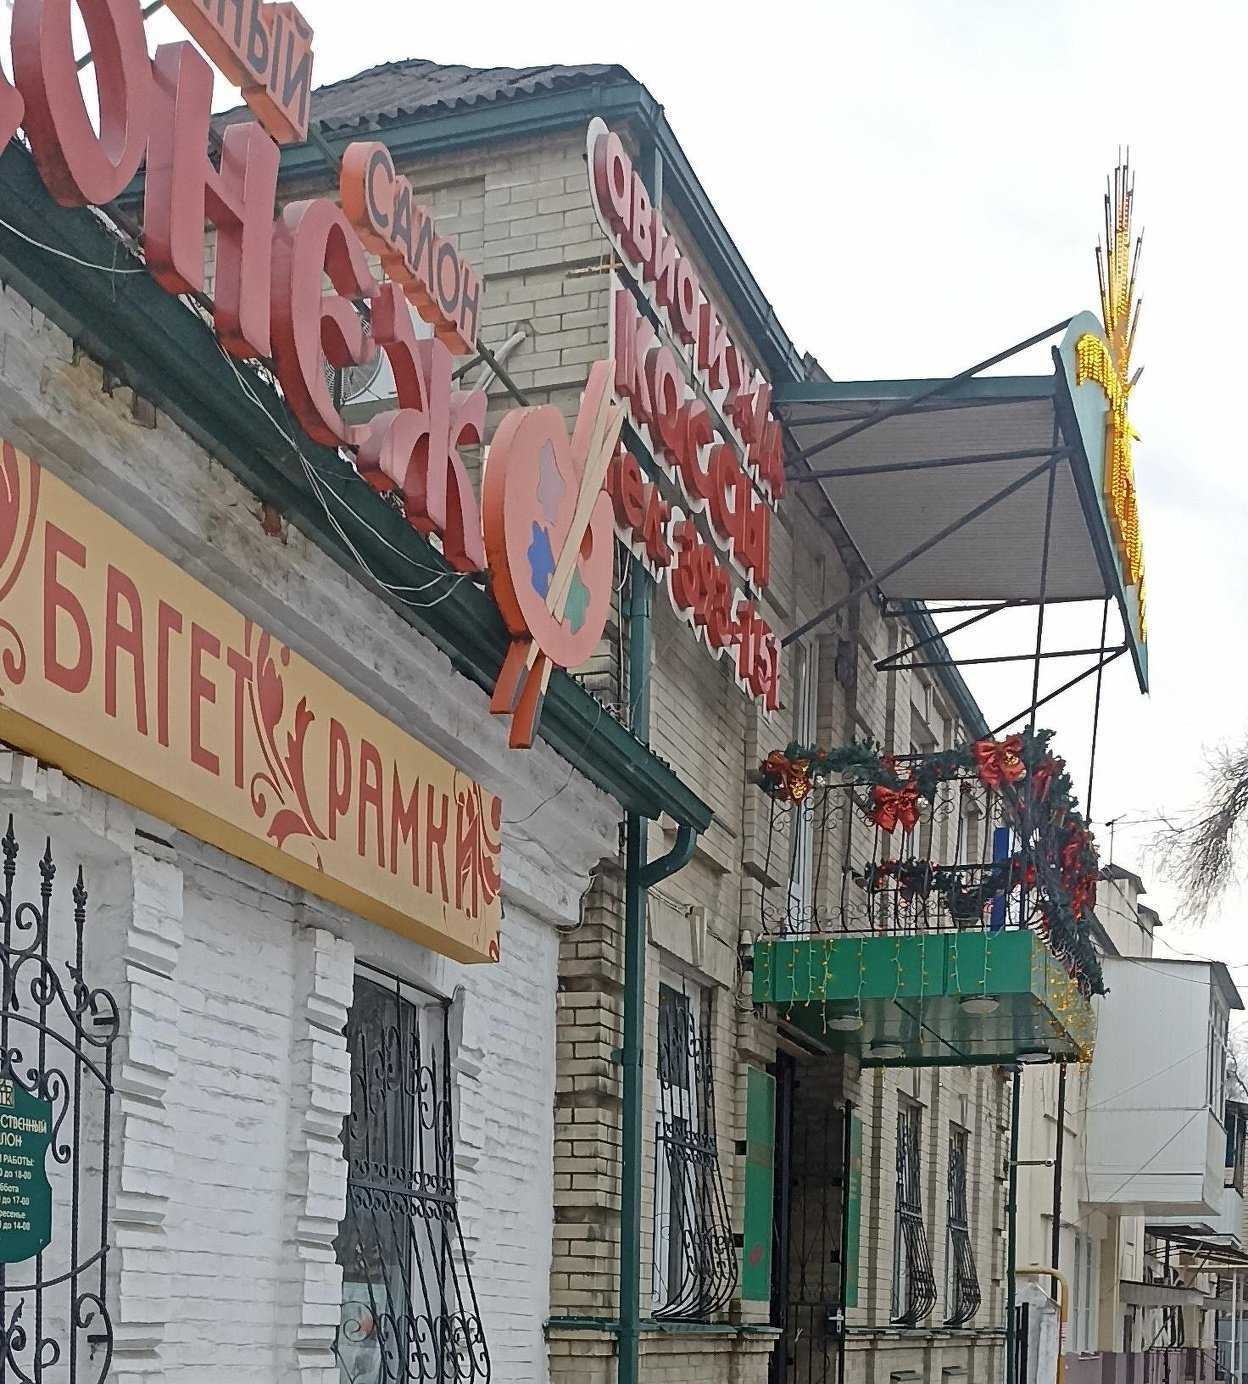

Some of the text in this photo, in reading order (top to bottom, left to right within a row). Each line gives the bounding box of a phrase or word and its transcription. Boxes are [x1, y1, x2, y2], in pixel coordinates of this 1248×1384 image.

[203, 0, 310, 129] НЫЙ
[0, 0, 487, 574] ОНЕЖ
[367, 150, 480, 344] САЛОН
[44, 520, 254, 790] БАГЕТ
[328, 717, 479, 919] РАМКИ
